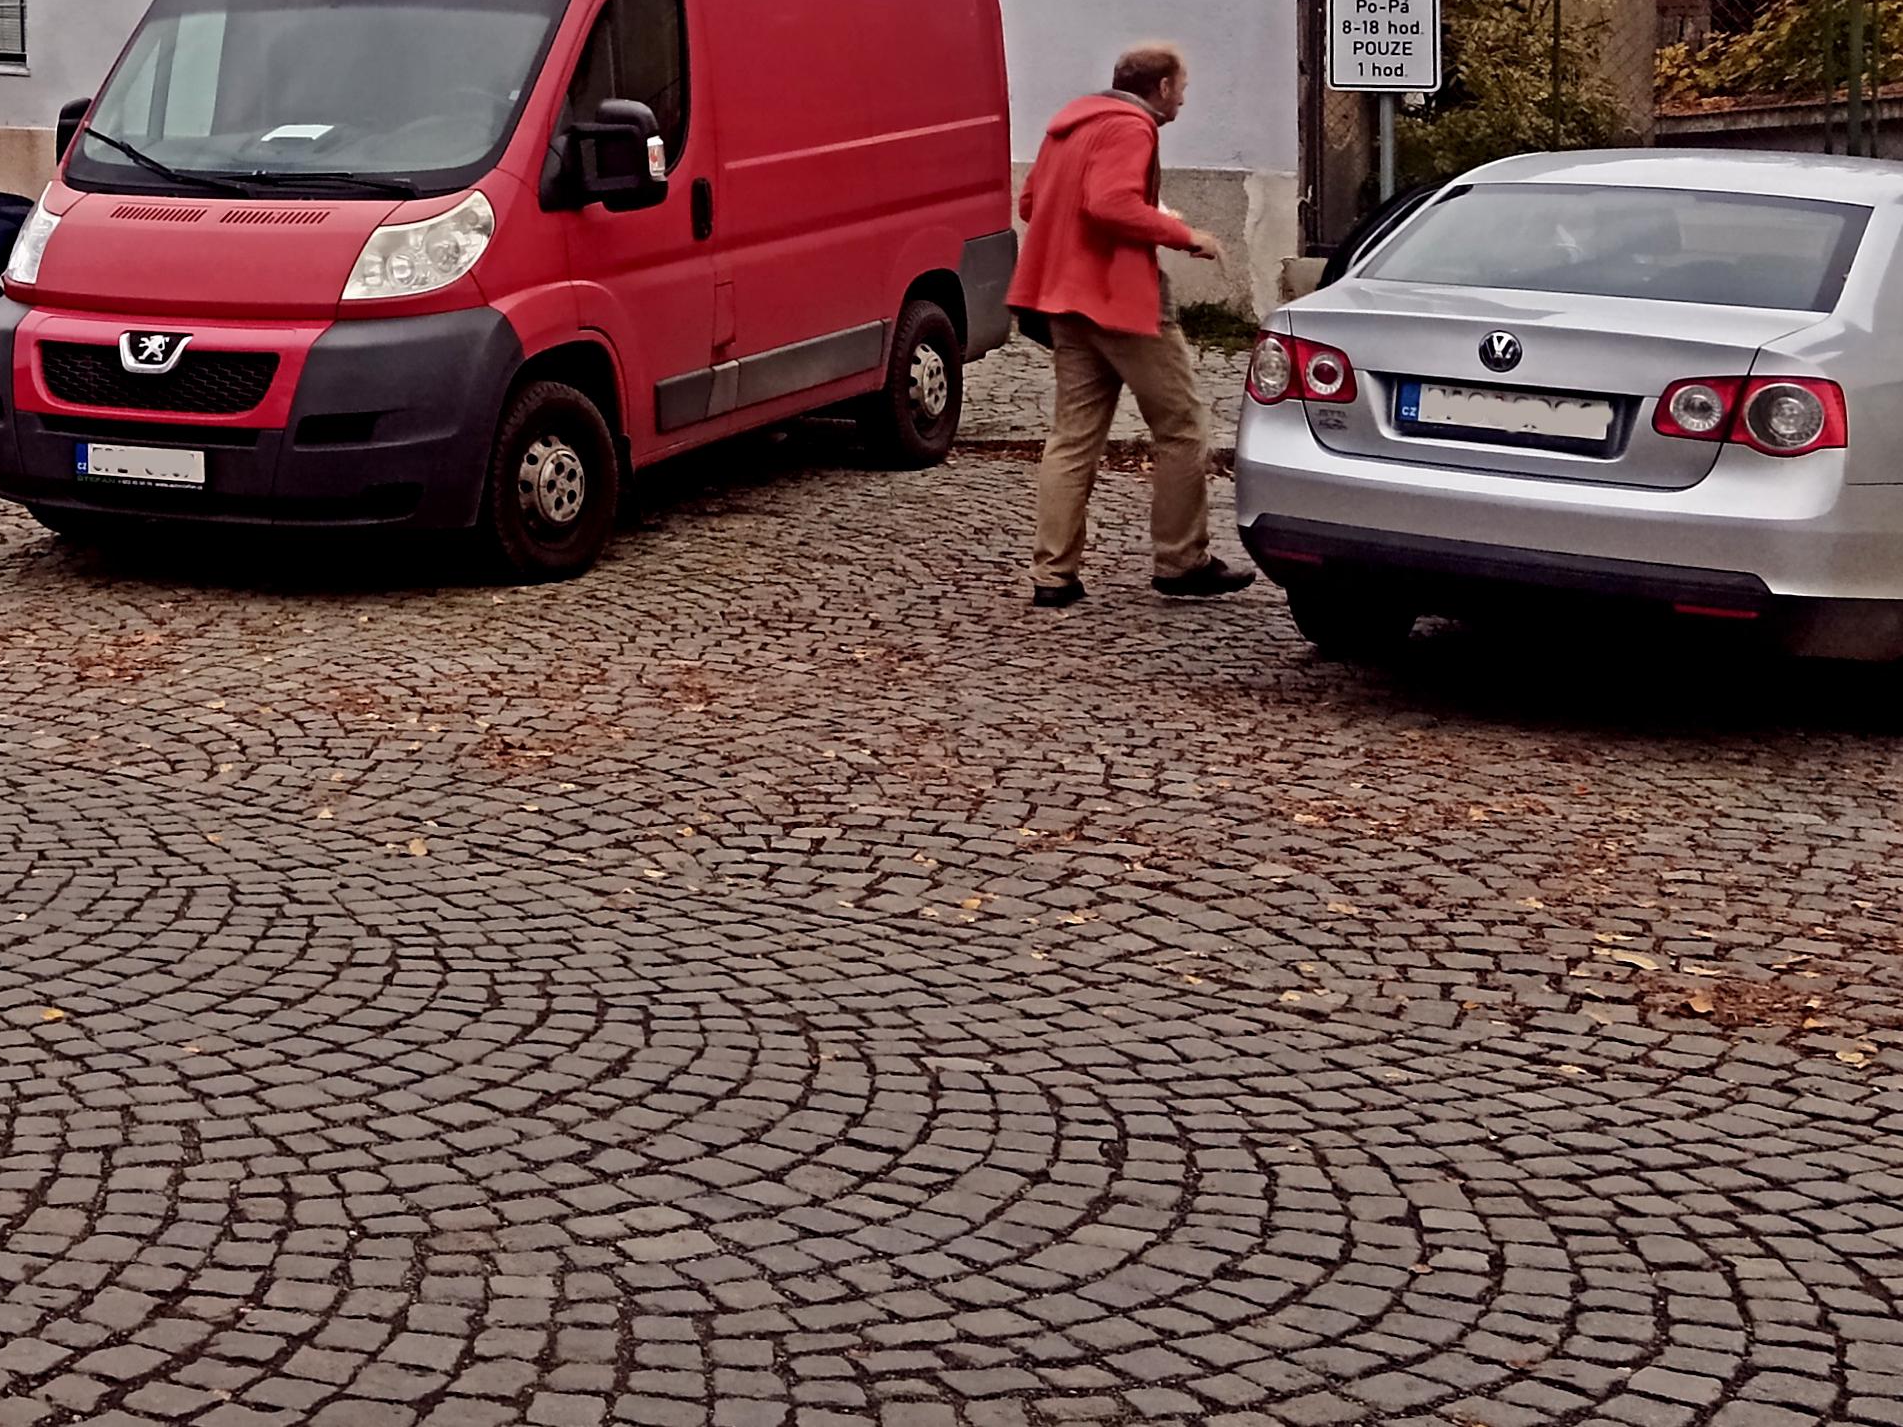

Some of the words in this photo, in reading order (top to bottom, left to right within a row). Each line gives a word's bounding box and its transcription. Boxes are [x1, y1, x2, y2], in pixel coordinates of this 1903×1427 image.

[1356, 0, 1410, 14] Po-Pá
[1342, 20, 1379, 35] 8-18
[1388, 20, 1424, 35] hod.
[1353, 41, 1413, 56] POUZE
[1358, 62, 1364, 77] 1
[1372, 62, 1408, 78] hod.
[1401, 405, 1417, 417] CZ
